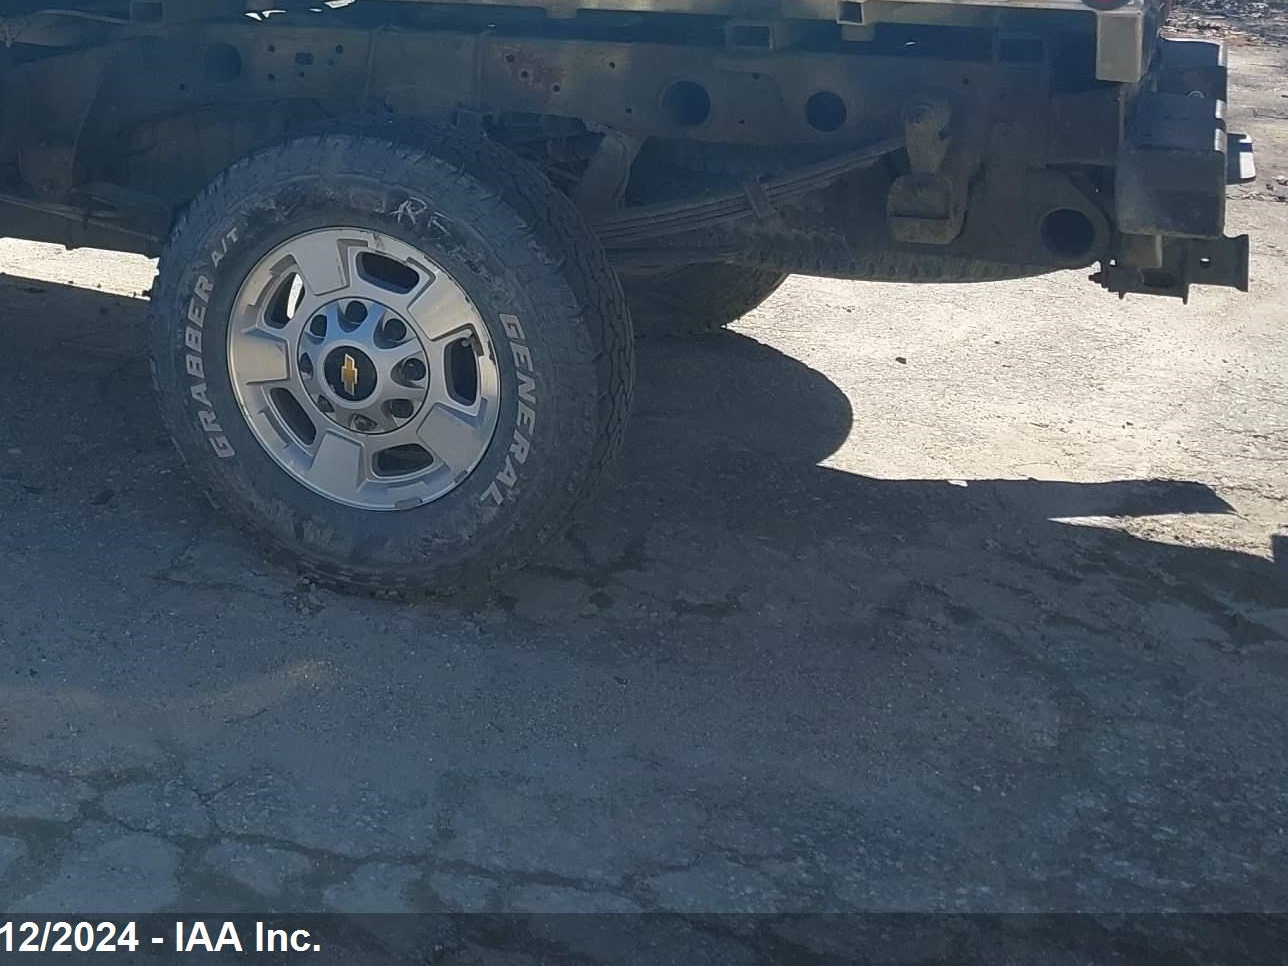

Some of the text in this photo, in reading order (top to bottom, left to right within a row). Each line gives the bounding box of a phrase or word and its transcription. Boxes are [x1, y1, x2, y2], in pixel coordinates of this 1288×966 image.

[184, 227, 239, 459] GRABBER A/T
[479, 313, 537, 506] GENERAL
